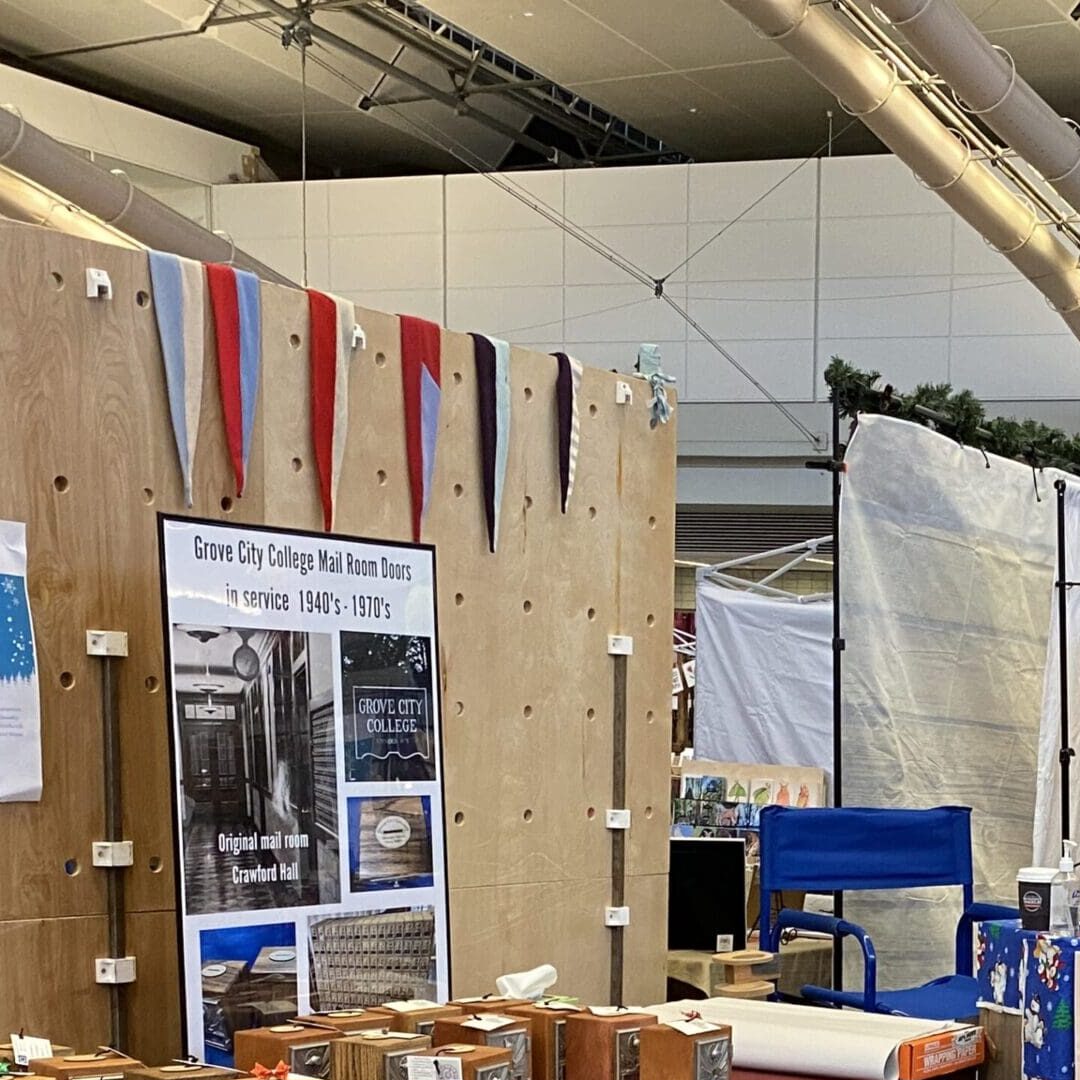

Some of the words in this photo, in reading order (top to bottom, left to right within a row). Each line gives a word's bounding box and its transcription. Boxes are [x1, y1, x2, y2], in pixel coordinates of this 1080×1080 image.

[194, 535, 233, 562] Grove
[238, 540, 263, 571] City
[268, 544, 314, 575] College
[318, 549, 343, 574] Mail
[346, 552, 378, 578] Room
[382, 556, 412, 581] Doors
[226, 583, 238, 608] in
[243, 587, 289, 611] service
[299, 589, 341, 615] 1940's
[352, 595, 391, 619] 1970's
[358, 698, 395, 715] GROVE
[398, 699, 423, 715] CITY
[366, 718, 418, 733] COLLEGE
[218, 832, 257, 856] Original
[260, 831, 282, 850] mail
[284, 834, 309, 848] room
[232, 864, 277, 884] Crawford
[280, 862, 299, 881] Hall
